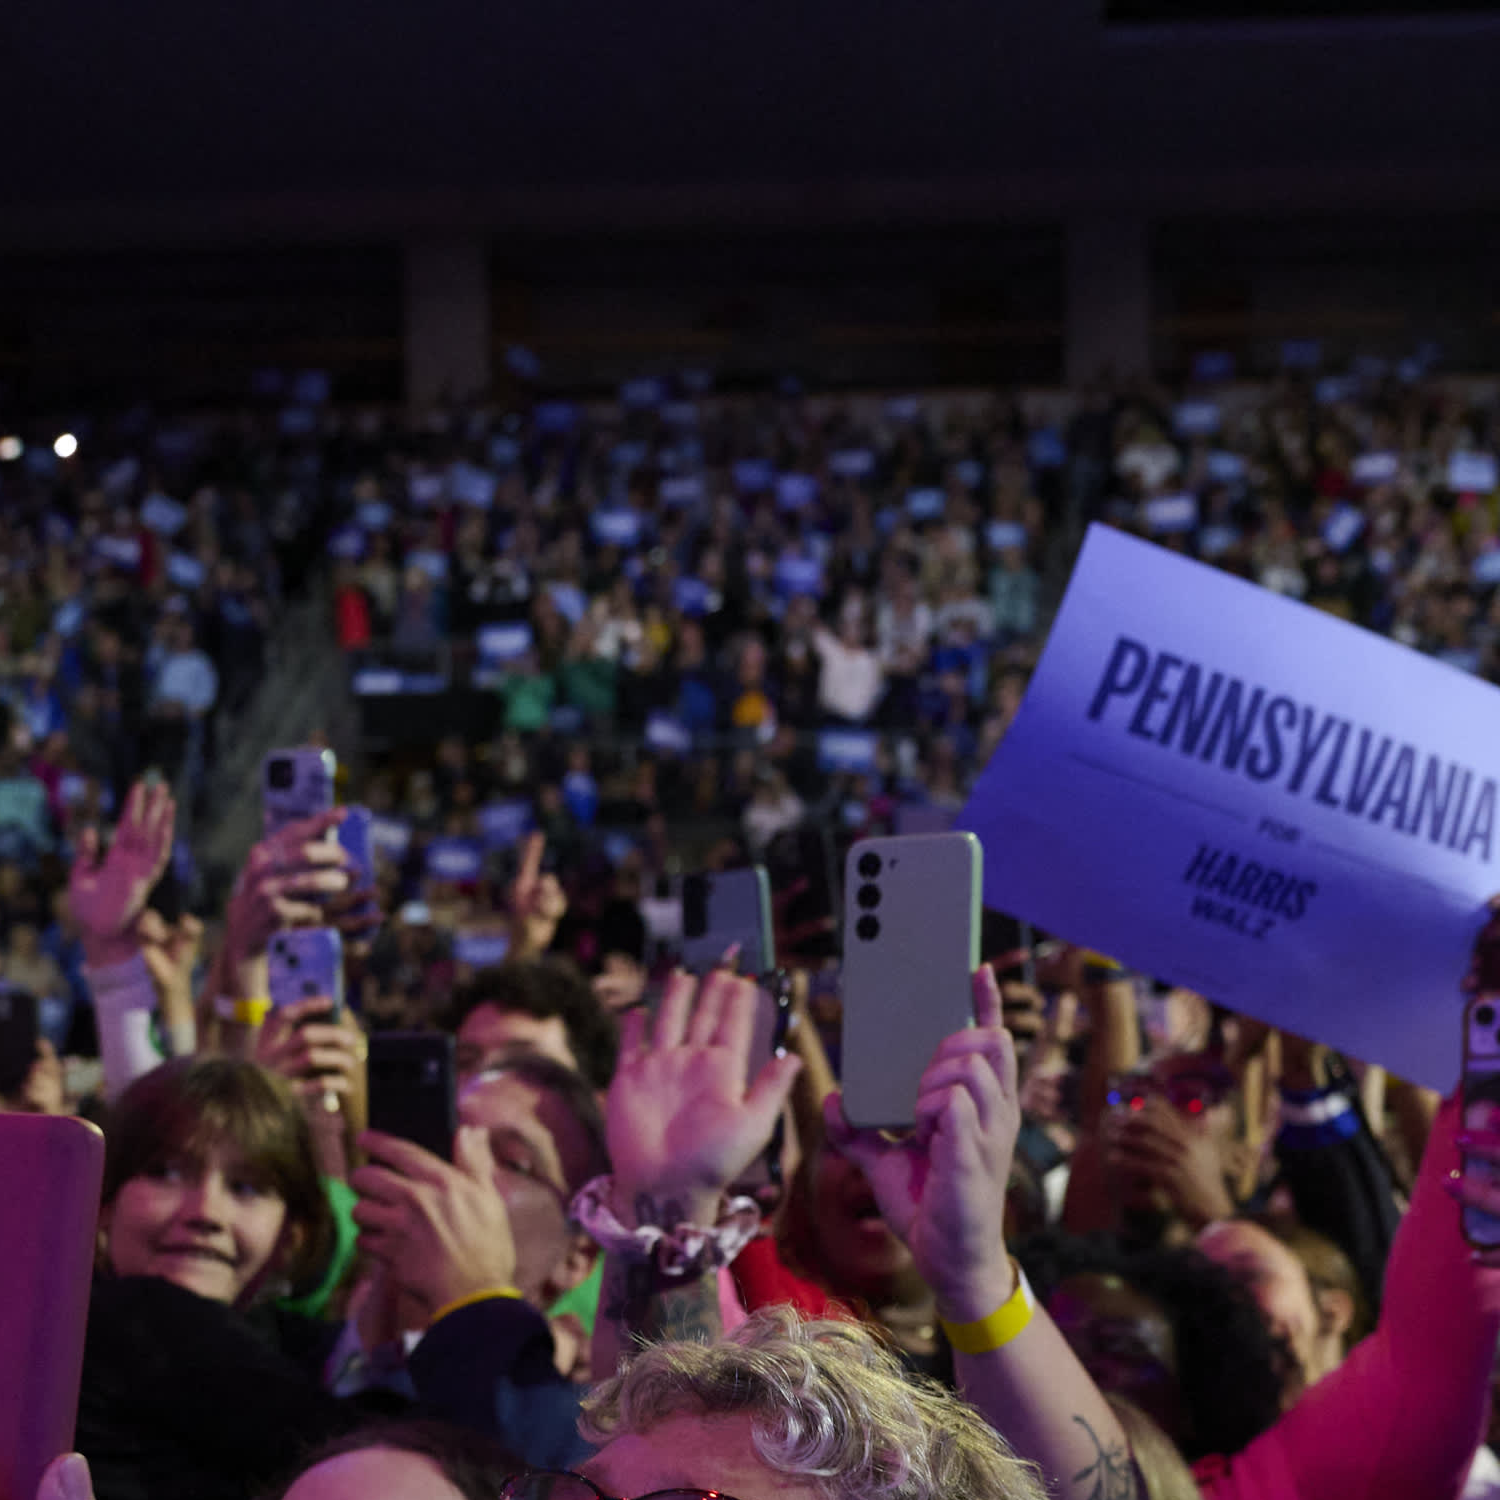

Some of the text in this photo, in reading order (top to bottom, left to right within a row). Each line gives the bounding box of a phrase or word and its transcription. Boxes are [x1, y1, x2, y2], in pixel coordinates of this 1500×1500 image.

[1087, 635, 1498, 862] PENNSYLVANIA
[1257, 816, 1303, 843] FOR
[1183, 843, 1318, 921] HARRIS
[1191, 896, 1277, 940] WALZ
